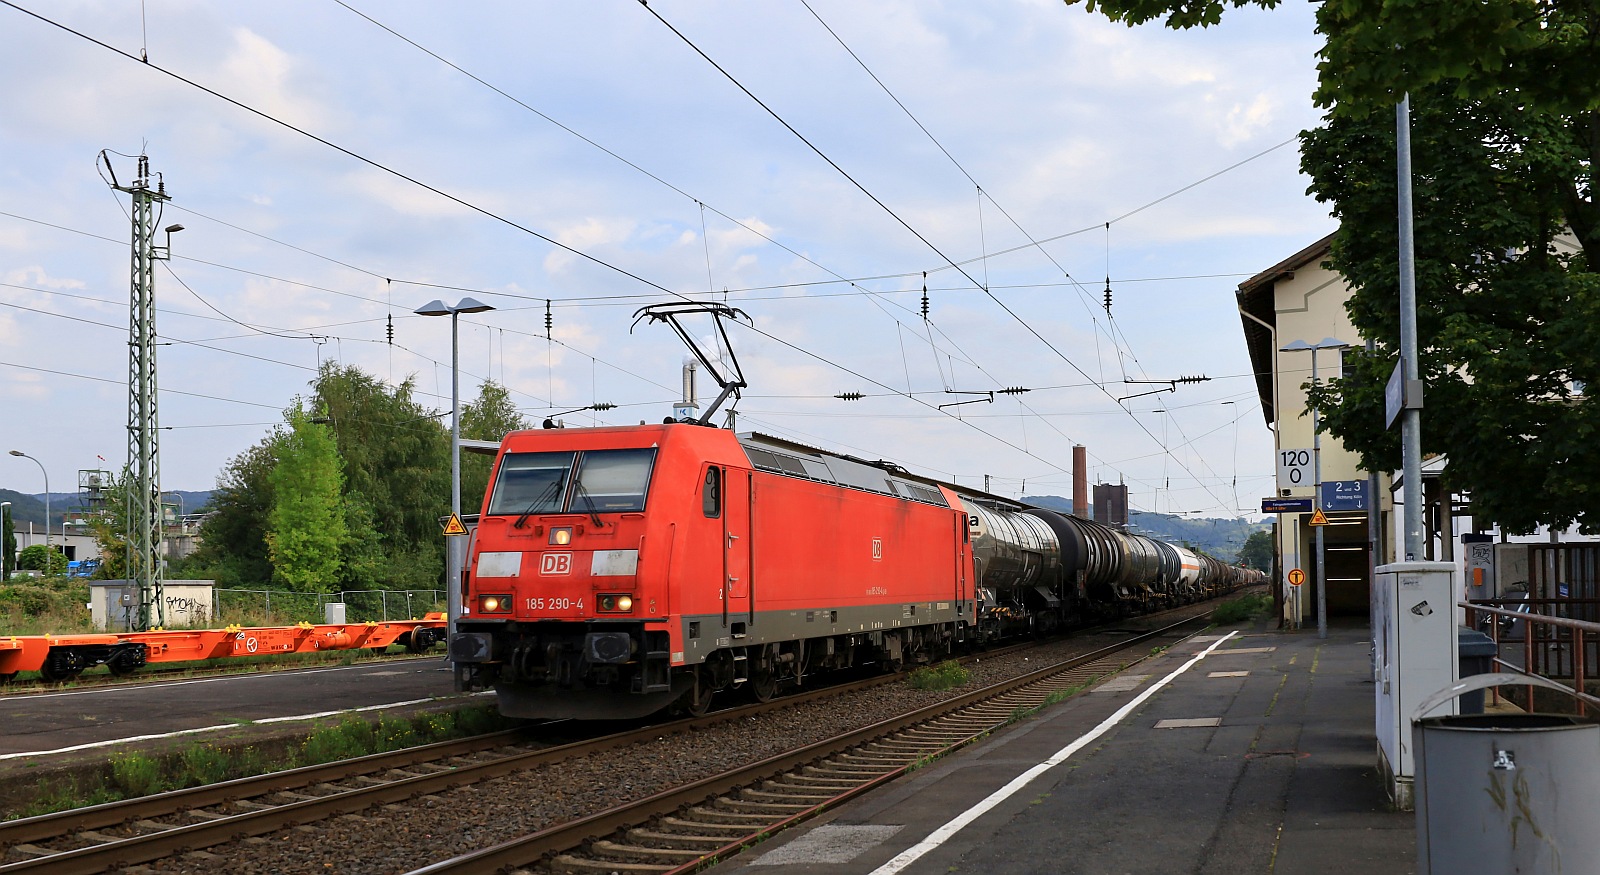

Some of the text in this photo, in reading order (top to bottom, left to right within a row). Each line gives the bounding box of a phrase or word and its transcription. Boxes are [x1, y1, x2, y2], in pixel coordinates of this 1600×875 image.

[1281, 451, 1309, 466] 120
[1290, 468, 1301, 483] 0
[1336, 482, 1342, 492] 2
[1354, 482, 1360, 491] 3
[873, 540, 881, 558] DB
[543, 555, 569, 573] DB
[525, 597, 584, 610] 185 290-4
